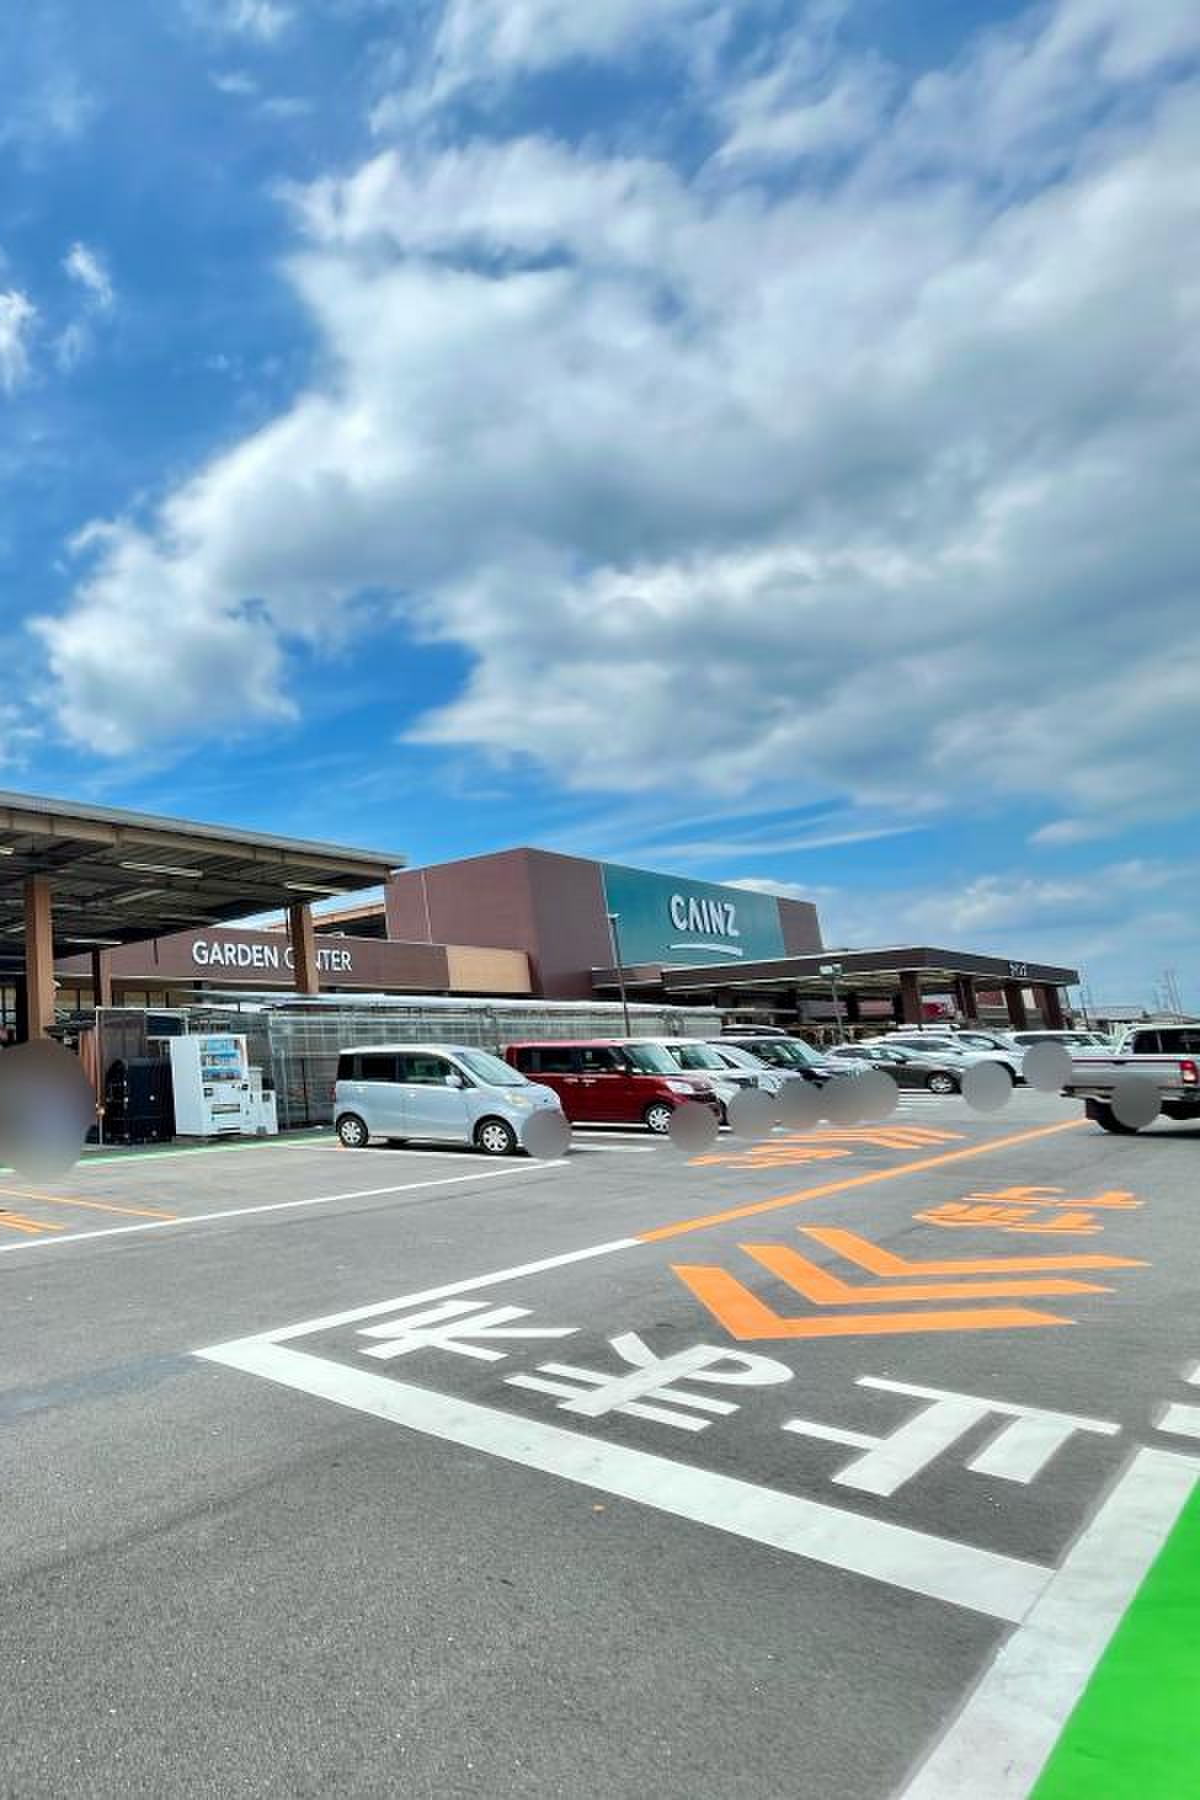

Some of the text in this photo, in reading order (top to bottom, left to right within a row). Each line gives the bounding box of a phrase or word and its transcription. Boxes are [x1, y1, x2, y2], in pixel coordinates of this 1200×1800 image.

[671, 895, 739, 936] CAINZ
[192, 941, 352, 972] GARDEN CTER
[357, 1301, 1121, 1496] 止まれ
